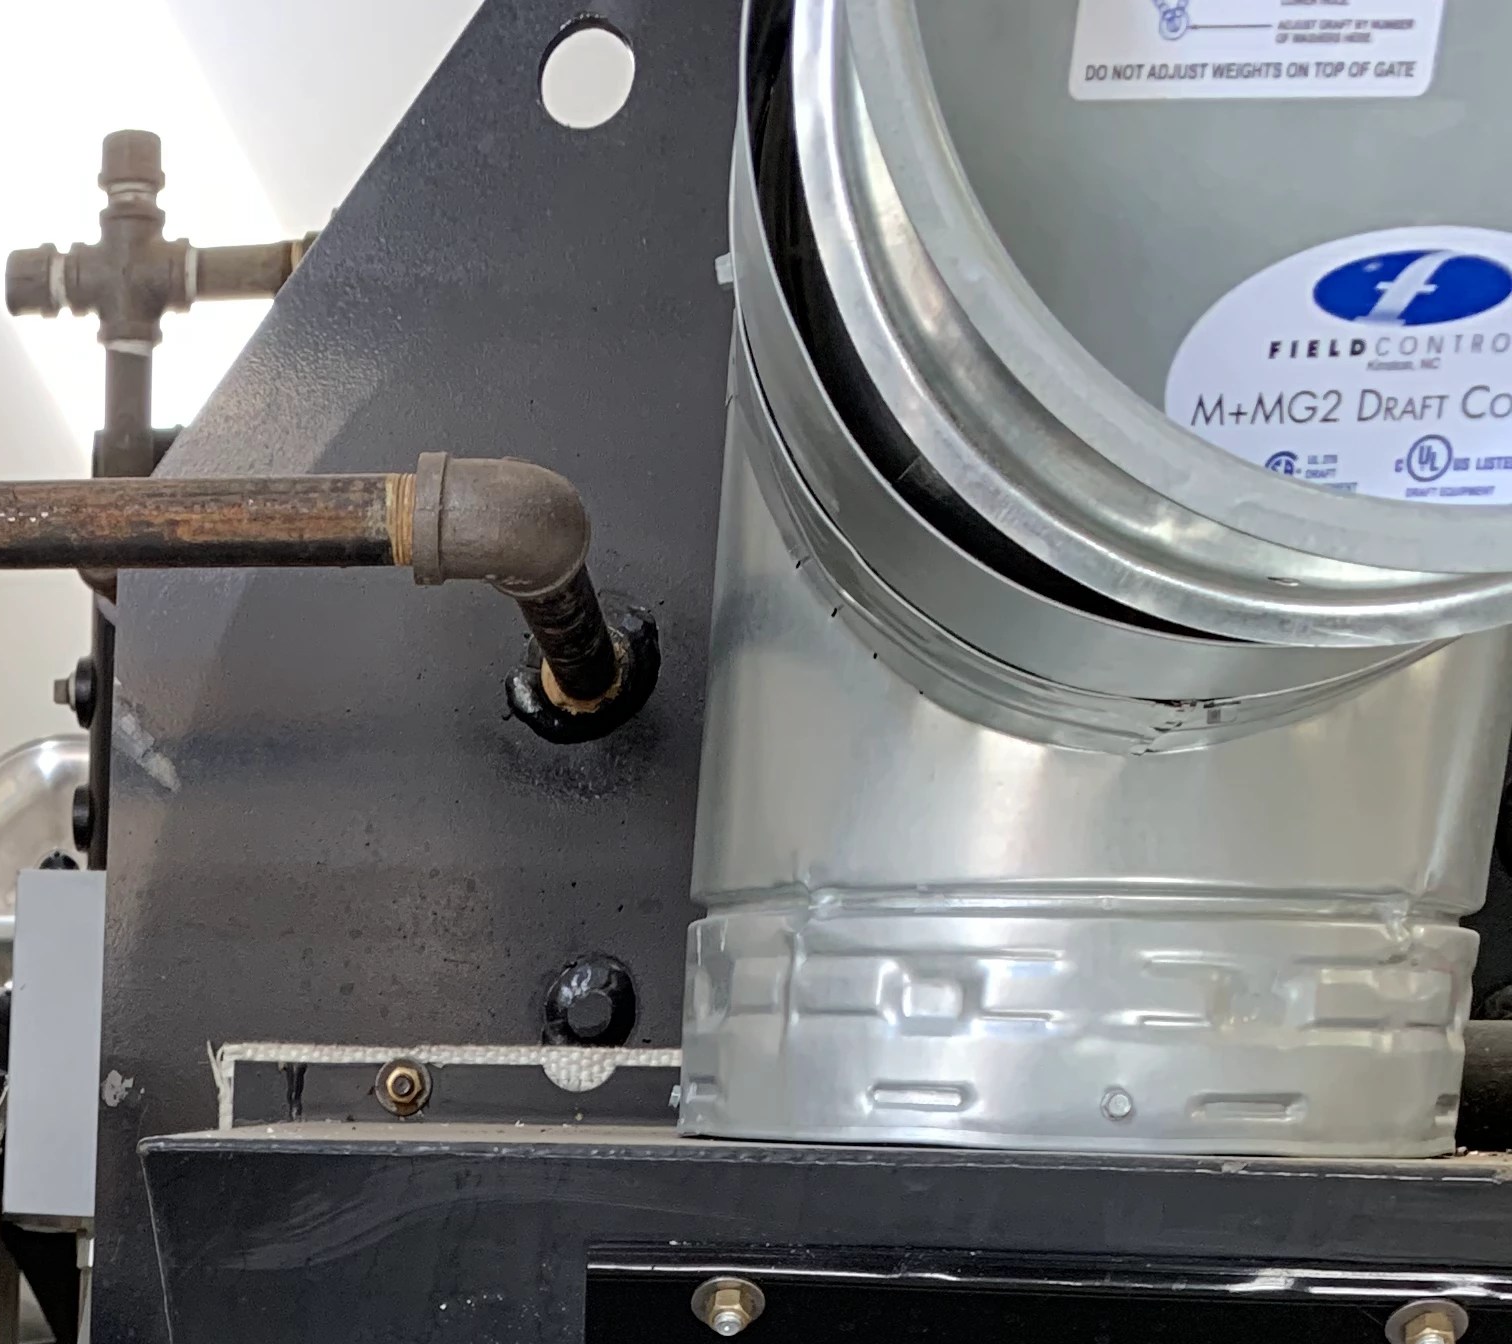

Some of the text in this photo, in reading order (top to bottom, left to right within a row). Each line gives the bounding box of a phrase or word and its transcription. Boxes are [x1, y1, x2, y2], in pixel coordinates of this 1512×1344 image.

[1085, 61, 1416, 81] DO NOT ADJUST WEIGHTS ON TOP OF GATE
[1190, 389, 1343, 426] M+MG2
